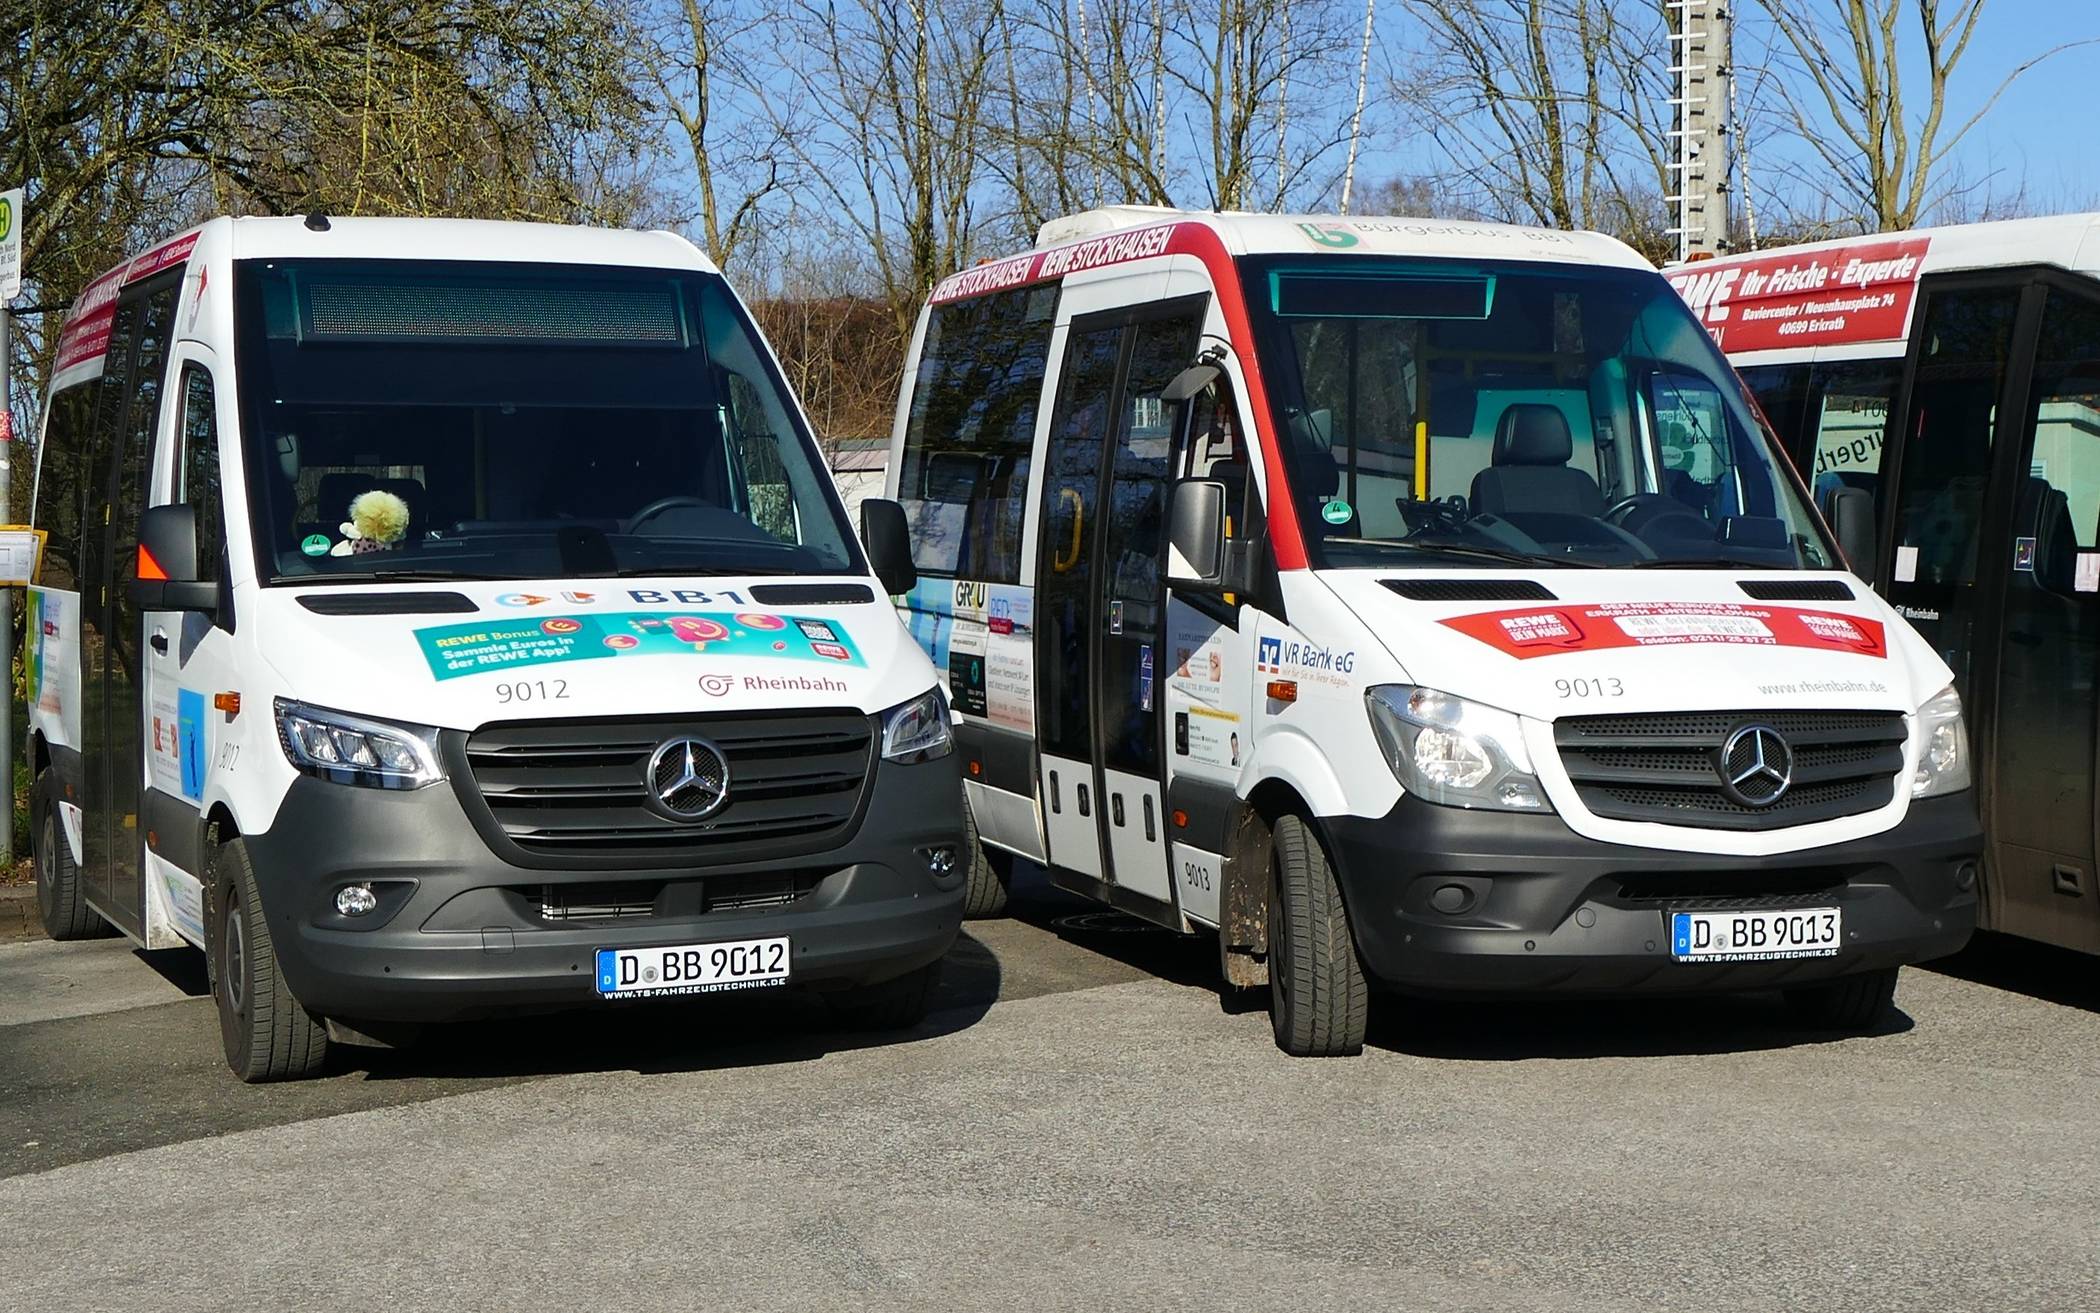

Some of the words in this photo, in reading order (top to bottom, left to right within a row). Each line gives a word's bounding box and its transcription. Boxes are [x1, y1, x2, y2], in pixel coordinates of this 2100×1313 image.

[1072, 225, 1176, 270] STOCKHAUSEN
[1739, 268, 1769, 297] Ihr
[1766, 261, 1827, 294] Frische
[1840, 253, 1917, 290] Experte
[1742, 302, 1798, 321] Baviercenter
[1805, 296, 1880, 315] Neuenhausplatz
[1881, 293, 1895, 307] 74
[1778, 320, 1808, 336] 40699
[1808, 317, 1845, 333] Erkrath
[627, 590, 746, 605] BB1
[1500, 613, 1561, 629] REWE
[1585, 609, 1651, 618] ERKRATH
[1658, 608, 1771, 618] UNTERFELDHAUS
[1798, 614, 1853, 630] REWE
[1905, 607, 1939, 620] Rheinbahn
[435, 633, 489, 648] REWE
[491, 628, 540, 642] Bonus
[1508, 630, 1537, 642] DEIN
[1538, 626, 1570, 638] MARKT
[1636, 636, 1689, 645] Telefon:
[442, 644, 508, 660] Sammle
[510, 638, 555, 651] Euros
[558, 636, 574, 646] in
[448, 657, 478, 671] der
[478, 651, 529, 665] REWE
[532, 646, 571, 658] App!
[1284, 640, 1300, 665] VR
[1302, 645, 1333, 671] Bank
[1335, 651, 1355, 673] eG
[496, 679, 570, 704] 9012
[743, 675, 848, 692] Rheinbahn
[1555, 677, 1624, 699] 9013
[1758, 680, 1888, 696] www.rheinbahn.de
[1185, 861, 1210, 891] 9013
[1694, 920, 1711, 949] D
[1732, 918, 1767, 948] BB
[1773, 914, 1835, 946] 9013
[620, 955, 639, 985] D
[662, 951, 702, 982] BB
[711, 943, 785, 978] 9012
